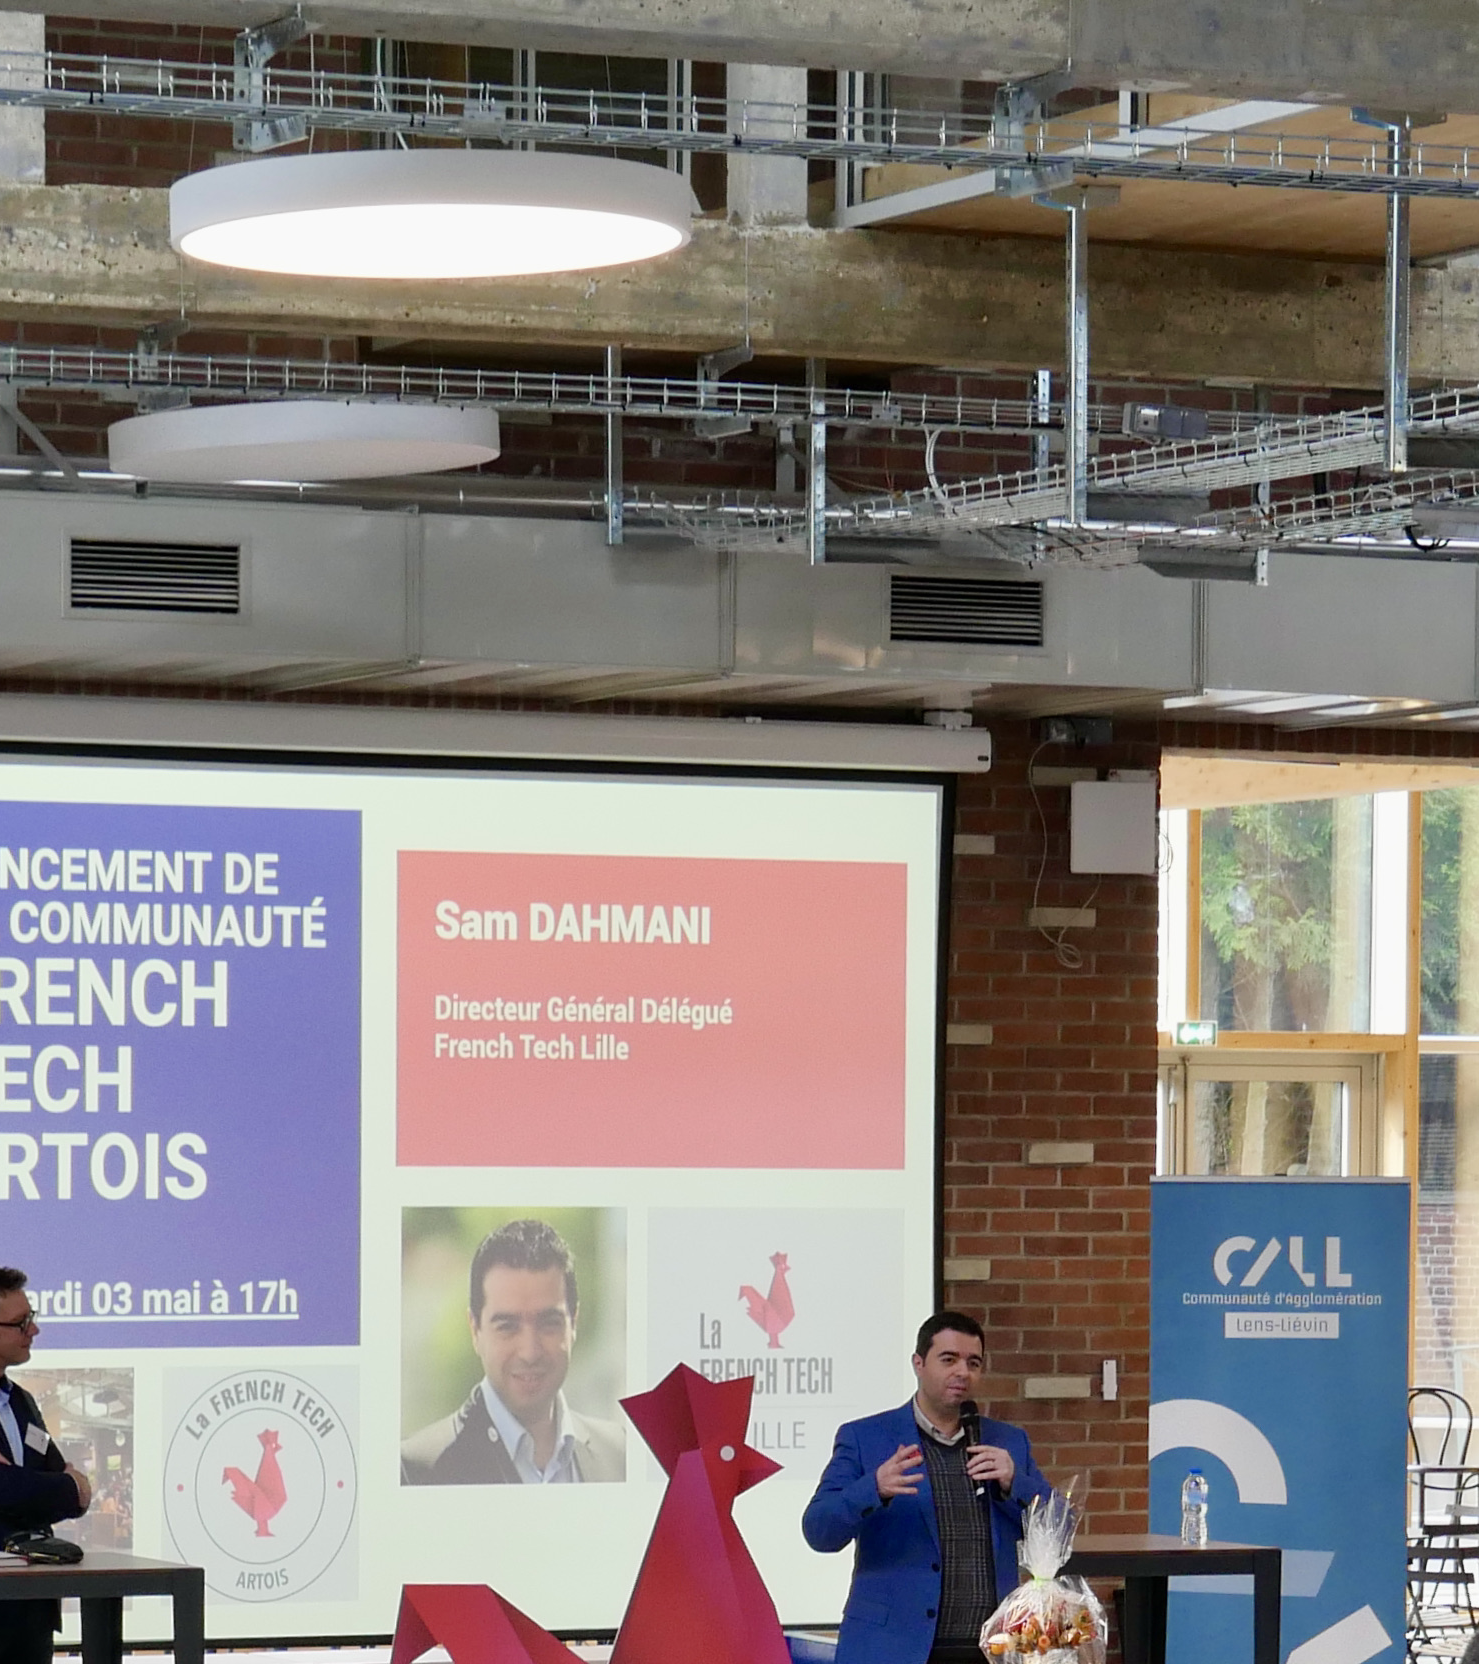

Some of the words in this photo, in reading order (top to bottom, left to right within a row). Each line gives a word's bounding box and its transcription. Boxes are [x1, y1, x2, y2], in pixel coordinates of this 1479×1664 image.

[224, 852, 279, 895] DE
[9, 896, 327, 948] COMMUNAUTÉ
[435, 899, 518, 941] Sam
[530, 903, 711, 945] DAHMANI
[434, 994, 541, 1022] Directeur
[547, 995, 635, 1024] Général
[642, 996, 733, 1029] Délégué
[434, 1033, 513, 1059] French
[520, 1033, 575, 1060] Tech
[581, 1034, 629, 1061] Lille
[1213, 1235, 1353, 1288] CALL
[31, 1280, 83, 1316] ardi
[92, 1281, 133, 1316] 03
[143, 1280, 201, 1316] mai
[211, 1279, 230, 1314] à
[239, 1279, 298, 1314] 17h
[1182, 1292, 1271, 1306] Communauté
[1274, 1292, 1382, 1308] d'Agglomération
[699, 1312, 722, 1350] La
[1236, 1316, 1329, 1333] Lens-Liévin
[783, 1356, 833, 1394] TECH
[185, 1413, 211, 1441] La
[209, 1379, 286, 1416] FRENCH
[291, 1389, 335, 1438] TECH
[754, 1421, 806, 1449] ILLE
[236, 1568, 290, 1590] ARTOIS
